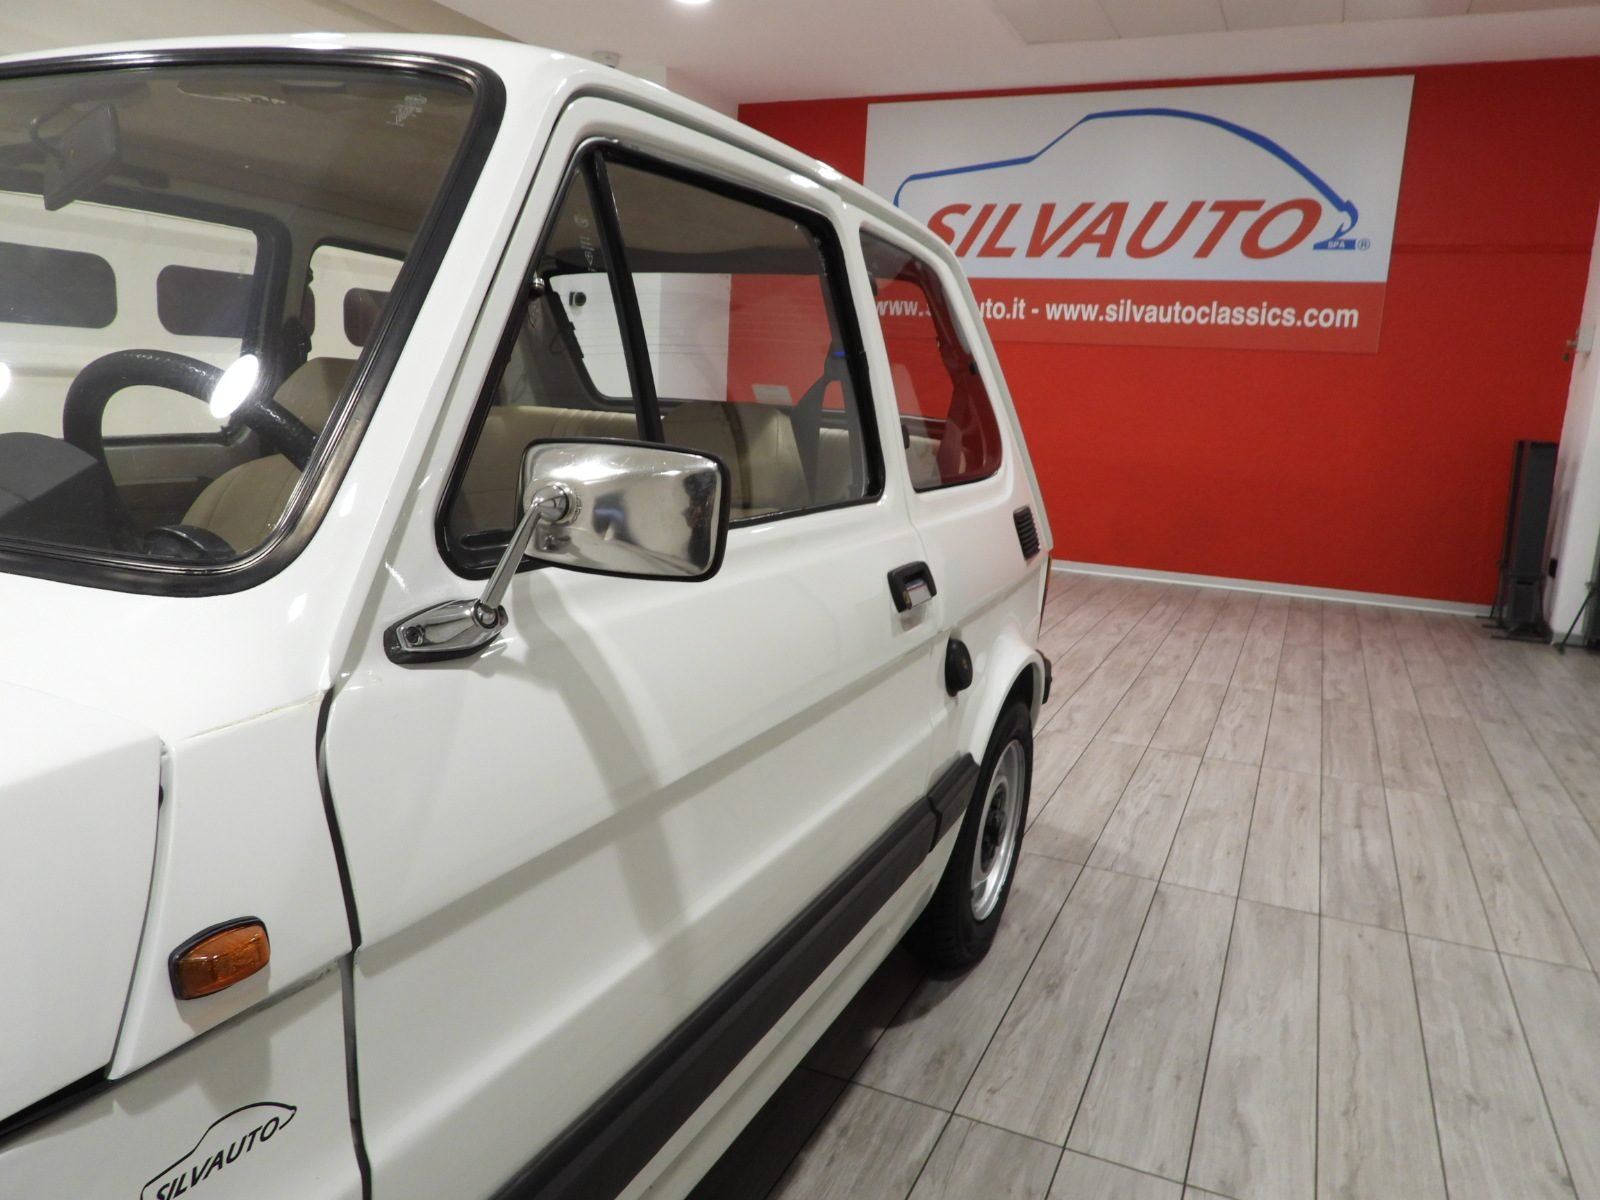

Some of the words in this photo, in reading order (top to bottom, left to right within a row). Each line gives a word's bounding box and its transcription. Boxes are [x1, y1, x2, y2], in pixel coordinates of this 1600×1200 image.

[927, 198, 1322, 260] SILVAUTO
[1045, 300, 1360, 329] www.silvautoclassics.com
[156, 1116, 280, 1200] SILVAUTO
